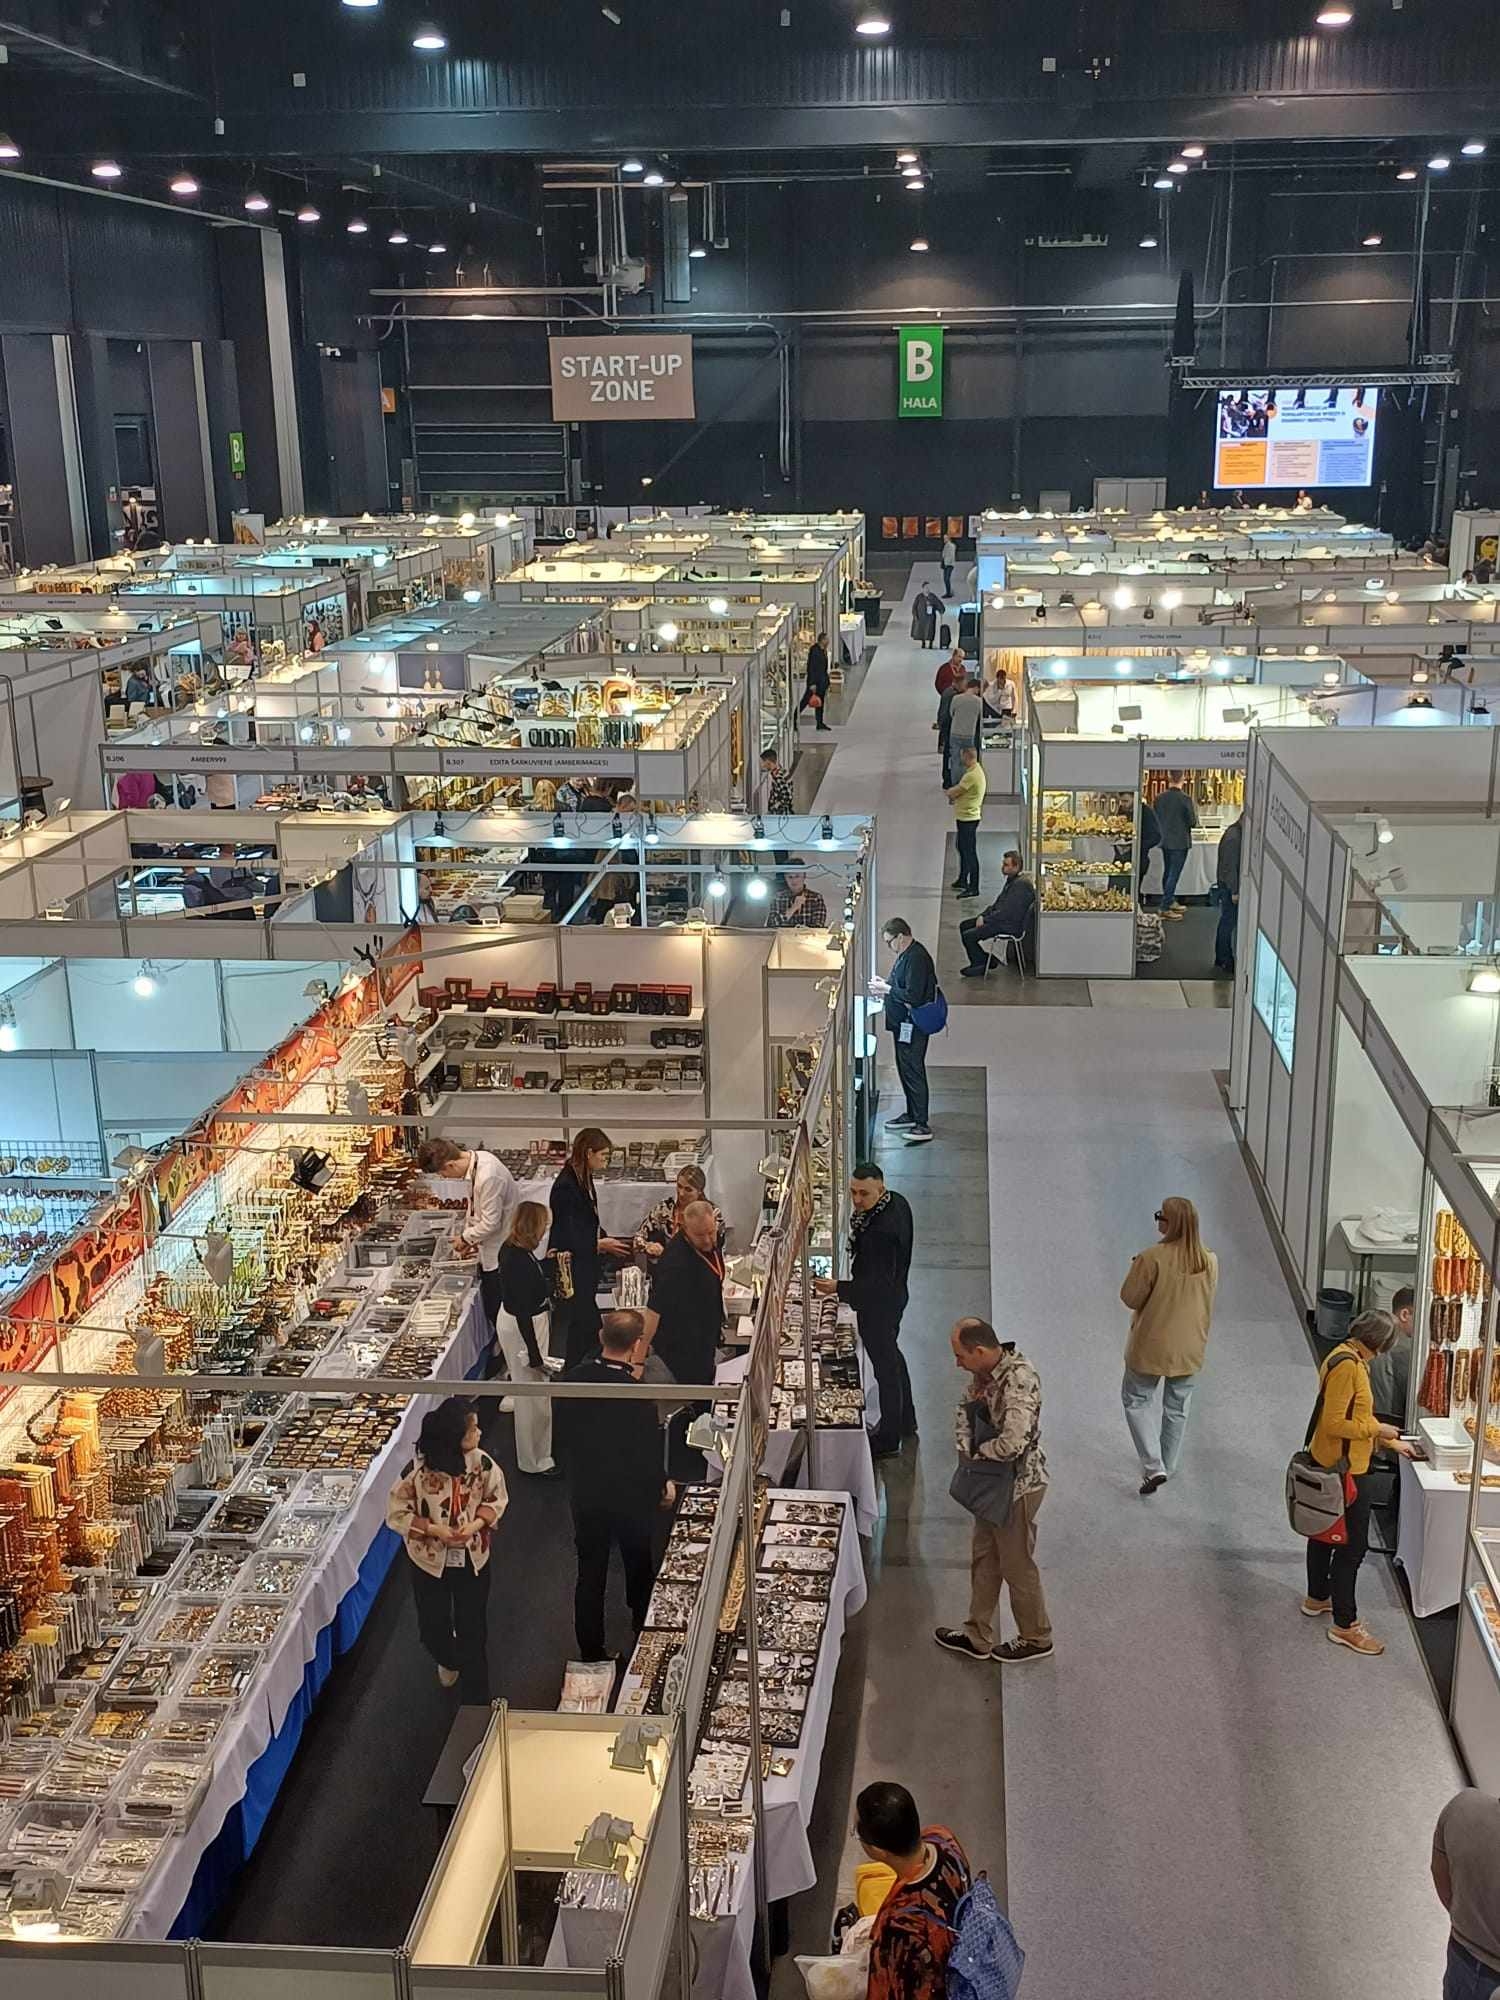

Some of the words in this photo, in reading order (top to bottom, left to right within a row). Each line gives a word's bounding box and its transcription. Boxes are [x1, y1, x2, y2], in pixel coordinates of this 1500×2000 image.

[560, 354, 683, 378] START-UP
[906, 340, 934, 382] B
[590, 379, 655, 402] ZONE
[903, 397, 938, 409] HALA
